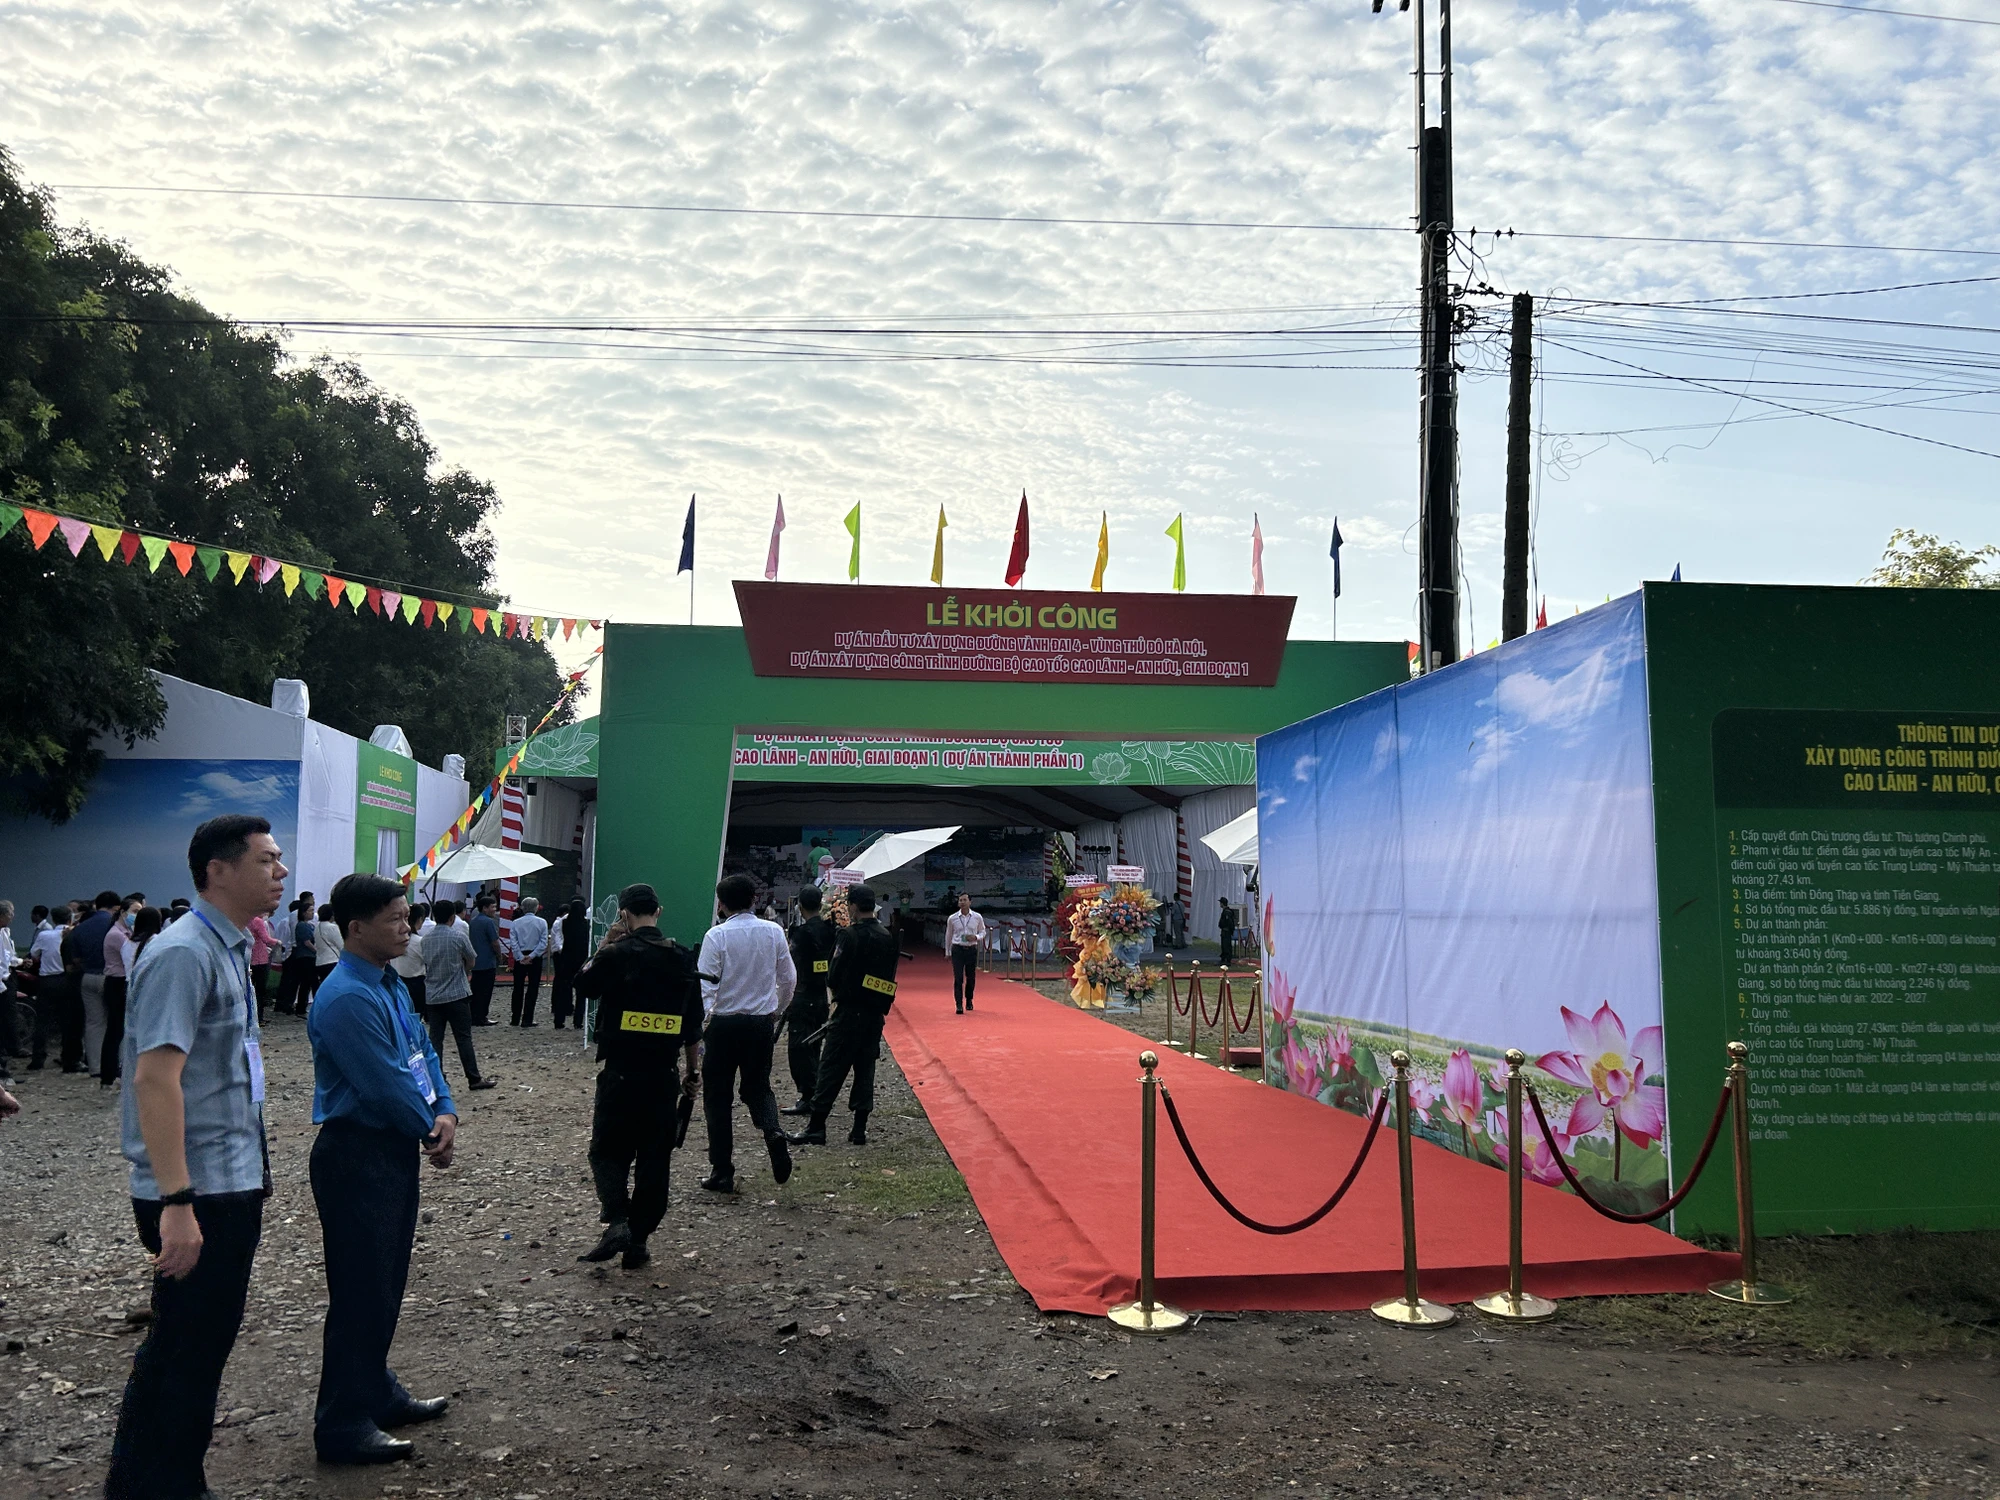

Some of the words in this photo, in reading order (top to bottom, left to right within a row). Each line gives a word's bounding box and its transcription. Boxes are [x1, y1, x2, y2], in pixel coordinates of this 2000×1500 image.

[927, 596, 959, 626] LỄ
[965, 599, 1032, 628] KHỞI
[1038, 602, 1117, 629] CÔNG
[835, 632, 853, 650] DỰ
[853, 630, 872, 648] ÁN
[873, 629, 899, 648] ĐẦU
[899, 633, 919, 648] TƯ
[918, 632, 942, 649] XÂY
[942, 635, 974, 652] DỰNG
[976, 634, 1016, 650] ĐƯỜNG
[1017, 635, 1050, 652] VÀNH
[1051, 638, 1072, 653] ĐAI
[1073, 639, 1082, 653] 4
[1089, 636, 1121, 654] VÙNG
[1123, 636, 1145, 654] THỦ
[1147, 637, 1164, 655] ĐÔ
[1165, 637, 1182, 655] HÀ
[1183, 638, 1207, 657] NỘI,
[791, 651, 811, 670] DỰ
[810, 650, 830, 667] ÁN
[830, 652, 855, 667] XÂY
[856, 653, 889, 671] DỰNG
[891, 652, 924, 669] CÔNG
[925, 653, 960, 670] TRÌNH
[961, 654, 1001, 671] ĐƯỜNG
[1003, 656, 1020, 674] BỘ
[1022, 658, 1045, 673] CAO
[1047, 655, 1070, 673] TỐC
[1071, 659, 1094, 673] CAO
[1096, 657, 1127, 674] LÃNH
[1134, 660, 1153, 675] AN
[1154, 658, 1182, 677] HỮU,
[1182, 661, 1207, 676] GIAI
[1208, 661, 1240, 678] ĐOẠN
[1240, 662, 1249, 676] 1
[1897, 722, 1947, 743] THÔNG
[1951, 725, 1975, 743] TIN
[734, 749, 761, 766] CAO
[761, 748, 797, 766] LÃNH
[808, 749, 829, 766] AN
[830, 747, 861, 767] HỮU,
[864, 750, 891, 766] GIAI
[892, 750, 929, 769] ĐOẠN
[931, 751, 939, 766] 1
[943, 750, 966, 770] (DỰ
[967, 748, 987, 767] ÁN
[989, 749, 1030, 768] THÀNH
[1033, 748, 1068, 769] PHẦN
[1070, 753, 1085, 771] 1)
[1805, 745, 1835, 766] XÂY
[1839, 747, 1881, 770] DỰNG
[1885, 746, 1926, 767] CÔNG
[1930, 746, 1974, 768] TRÌNH
[1844, 773, 1873, 791] CAO
[1878, 770, 1917, 792] LÃNH
[1932, 774, 1953, 792] AN
[1957, 772, 1991, 795] HỮU,
[1741, 829, 1759, 842] Cấp
[1762, 829, 1786, 842] quyết
[1789, 831, 1808, 842] định
[1811, 830, 1828, 841] Chủ
[1863, 831, 1879, 842] đầu
[1742, 845, 1768, 857] Phạm
[1783, 845, 1798, 855] đầu
[1817, 844, 1839, 855] điểm
[1842, 844, 1859, 855] đầu
[1862, 847, 1880, 858] giao
[1927, 848, 1942, 856] cao
[1979, 848, 1990, 857] An
[1731, 858, 1753, 869] điểm
[1779, 860, 1798, 872] giao
[1845, 862, 1861, 870] cao
[1881, 861, 1907, 873] Trung
[1732, 874, 1764, 886] khoảng
[1745, 889, 1759, 901] Địa
[1809, 888, 1833, 901] Đồng
[1836, 889, 1858, 901] Tháp
[1821, 903, 1837, 914] đầu
[1854, 905, 1880, 915] 5.886
[1746, 919, 1759, 930] Dự
[1762, 920, 1772, 929] án
[1775, 919, 1800, 929] thành
[1742, 933, 1754, 945] Dự
[1757, 935, 1768, 943] án
[1771, 934, 1795, 944] thành
[1798, 933, 1820, 946] phần
[1824, 934, 1828, 943] 1
[1748, 948, 1780, 960] khoảng
[816, 962, 826, 970] CS
[1744, 963, 1757, 975] Dự
[1760, 965, 1771, 973] án
[1774, 963, 1798, 973] thành
[1802, 963, 1824, 975] phần
[1827, 963, 1833, 973] 2
[866, 977, 893, 992] CSCĐ
[1774, 994, 1793, 1005] gian
[1871, 993, 1893, 1003] 2022
[1752, 1008, 1769, 1020] Quy
[629, 1015, 675, 1030] CSCĐ
[1748, 1021, 1771, 1035] Tổng
[1775, 1022, 1800, 1033] chiều
[1821, 1023, 1854, 1035] khoảng
[1769, 1040, 1786, 1048] cao
[1789, 1038, 1803, 1048] tốc
[1807, 1038, 1833, 1050] Trung
[1749, 1053, 1767, 1065] Quy
[1788, 1054, 1804, 1065] giai
[1806, 1053, 1829, 1064] đoạn
[1762, 1067, 1776, 1078] tốc
[1780, 1069, 1798, 1078] khai
[1751, 1083, 1768, 1096] Quy
[1789, 1084, 1805, 1096] giai
